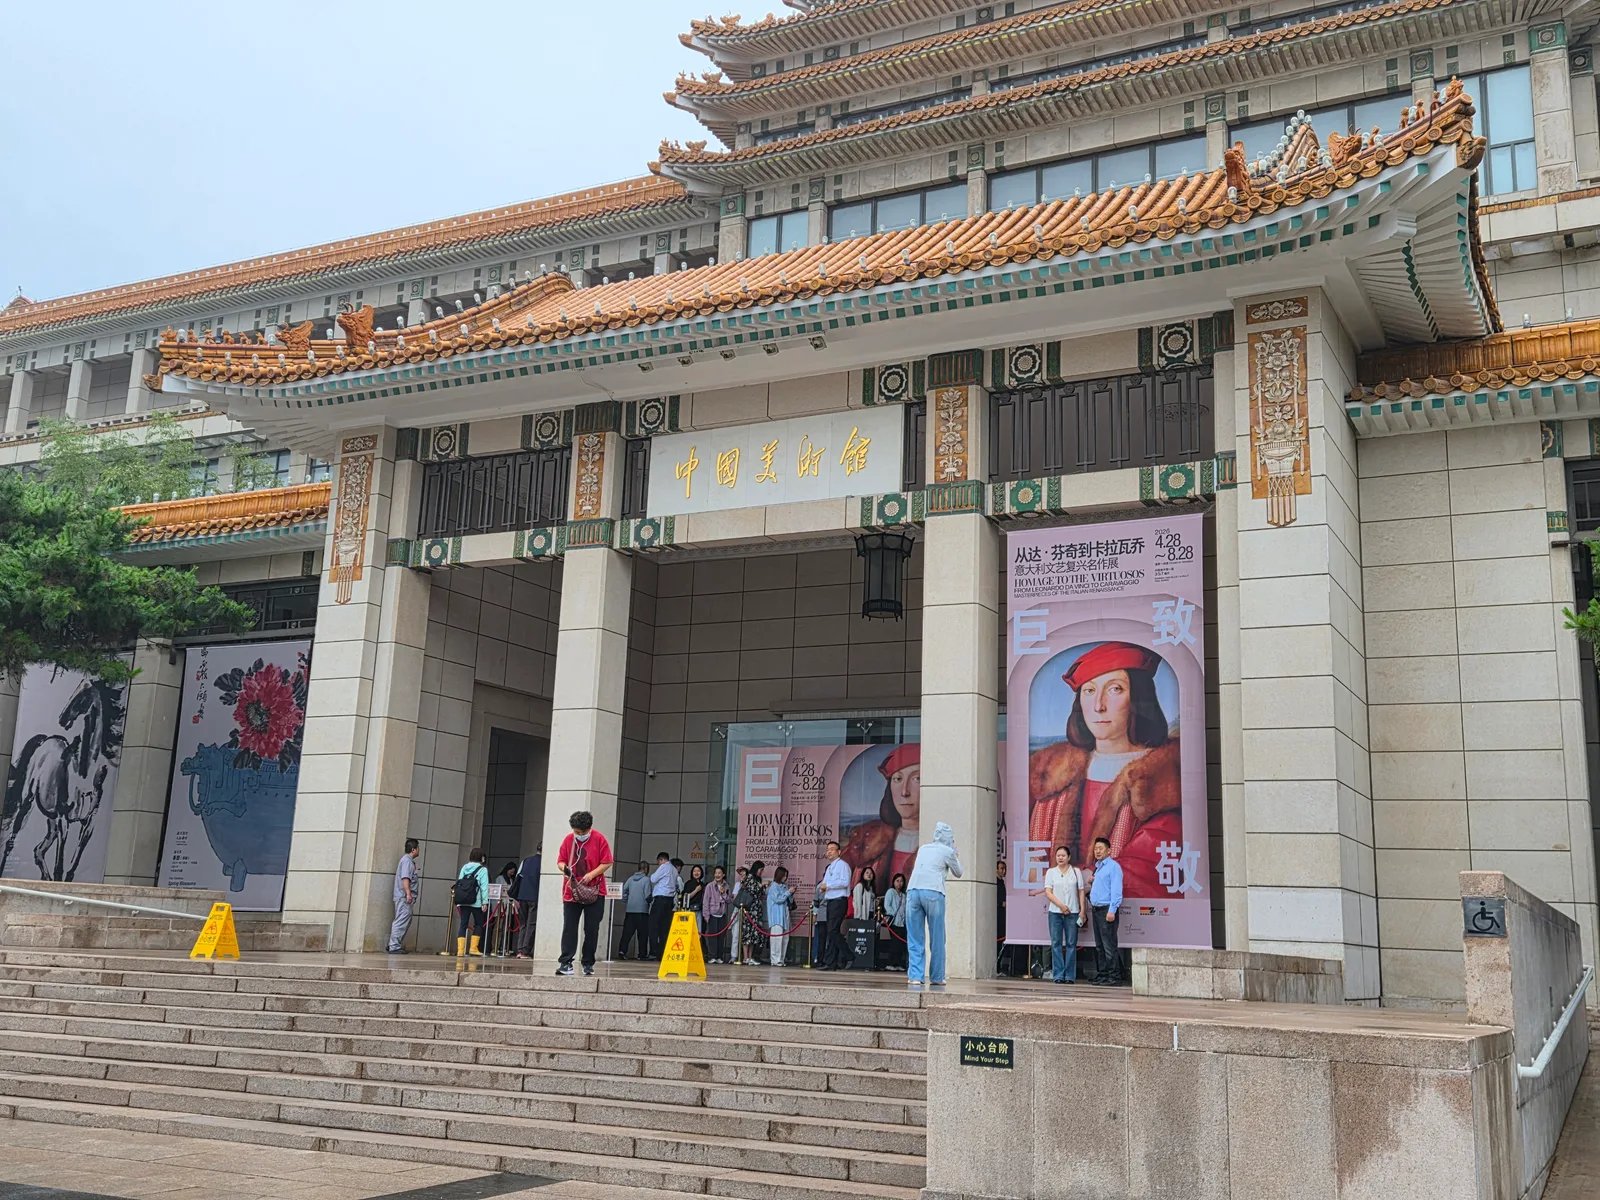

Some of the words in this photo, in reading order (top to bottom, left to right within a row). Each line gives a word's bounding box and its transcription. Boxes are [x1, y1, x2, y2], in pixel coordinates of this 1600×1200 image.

[1155, 533, 1181, 548] 4.28
[1014, 537, 1145, 563] 从达·芬奇到卡拉瓦乔
[1014, 557, 1119, 576] 意大利文艺复兴名作展
[1014, 576, 1054, 587] HOMAGE
[1055, 575, 1068, 585] TO
[1068, 574, 1088, 583] THE
[1091, 569, 1145, 581] VIRTUOSOS
[1031, 584, 1064, 592] LEONARDO
[1100, 579, 1140, 587] CARAVAGGIO
[1152, 597, 1197, 647] 致
[1013, 609, 1050, 655] 巨
[744, 754, 781, 803] 巨
[792, 763, 815, 777] 4.28
[747, 813, 794, 825] HOMAGE
[797, 813, 813, 825] TO
[746, 825, 768, 837] THE
[772, 824, 833, 837] VIRTUOSOS
[1013, 841, 1051, 889] 匠
[1155, 840, 1203, 894] 敬
[965, 1040, 1009, 1054] 小心台阶
[995, 1057, 1009, 1065] Step
